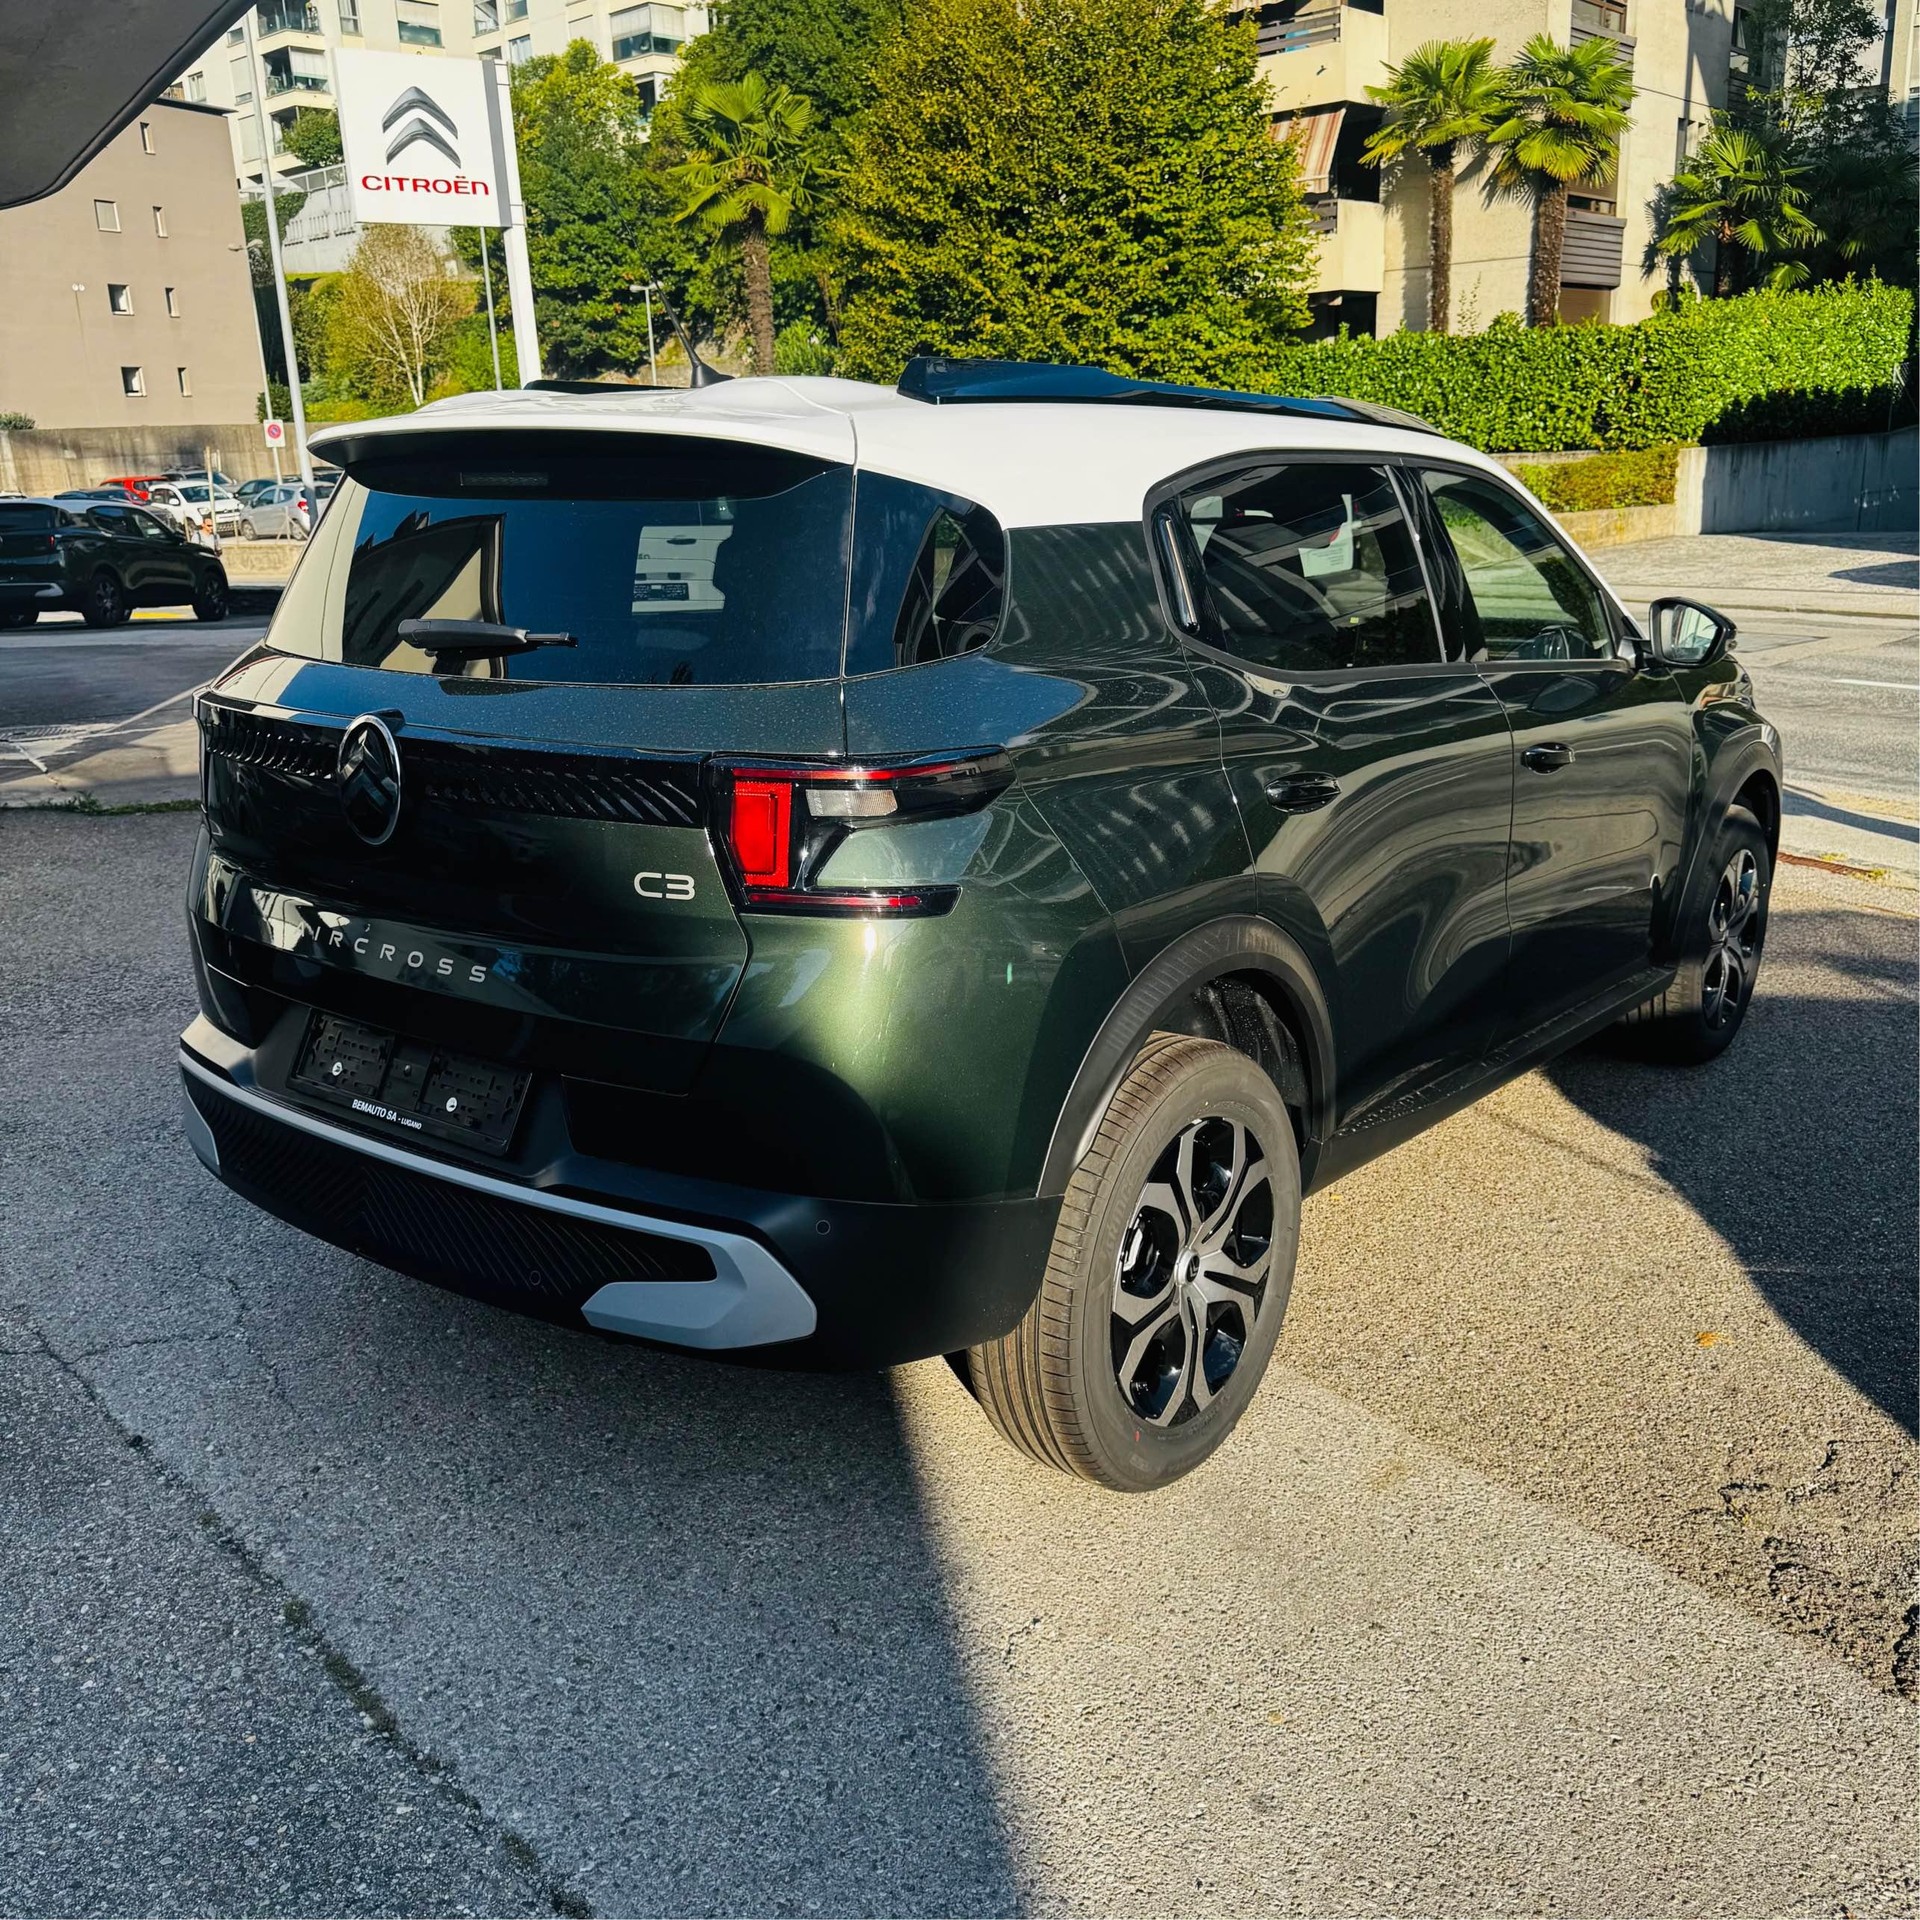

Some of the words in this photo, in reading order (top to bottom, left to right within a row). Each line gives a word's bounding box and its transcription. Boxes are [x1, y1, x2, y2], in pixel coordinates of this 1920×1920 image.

[634, 872, 695, 900] C3
[295, 921, 487, 983] AIRCROSS
[352, 1099, 387, 1118] BEMAUTO
[386, 1110, 397, 1122] SA
[401, 1117, 422, 1130] LUGANO
